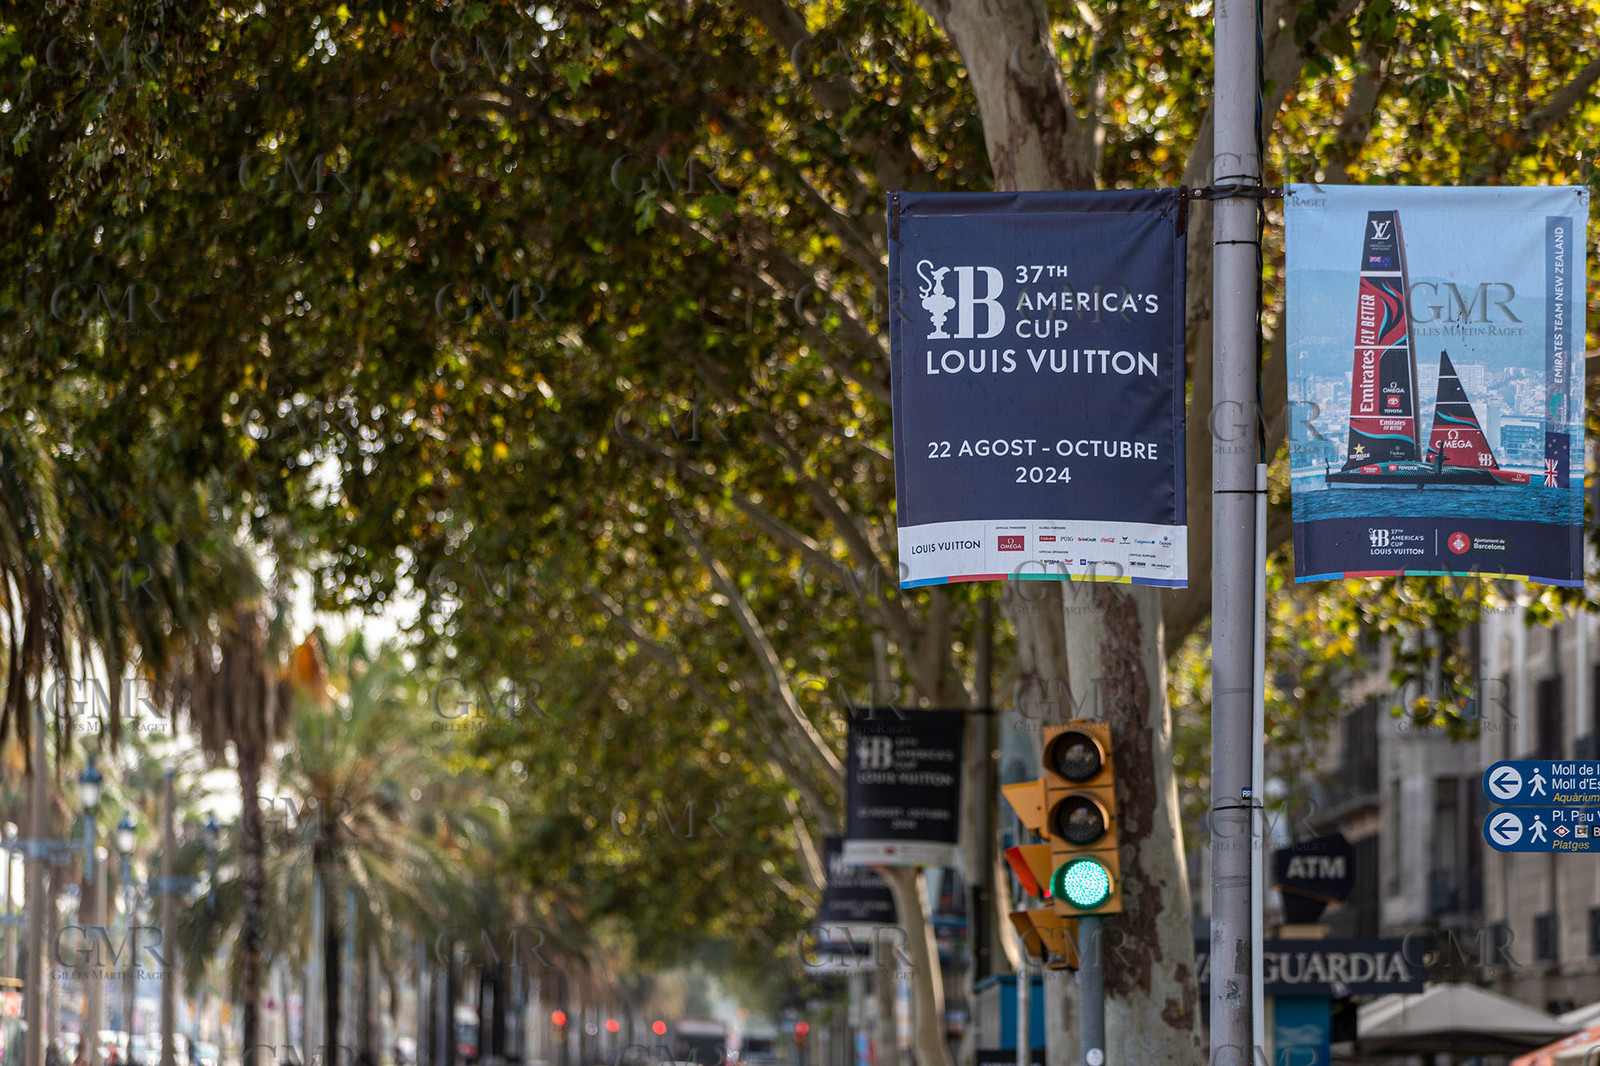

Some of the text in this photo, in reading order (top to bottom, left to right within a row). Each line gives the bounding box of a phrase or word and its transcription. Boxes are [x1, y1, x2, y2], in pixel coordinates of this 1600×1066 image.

[1554, 227, 1564, 275] ZEALAND
[1015, 265, 1068, 284] 37TH
[1554, 276, 1564, 301] NEW
[1015, 292, 1159, 314] AMERICA'S
[1554, 303, 1564, 332] TEAM
[1015, 319, 1068, 339] CUP
[926, 348, 1158, 377] LOUIS VUITTON
[1360, 294, 1375, 413] Emirates FLY BETTER
[1554, 334, 1564, 385] EMIRATES
[928, 441, 951, 459] 22
[958, 439, 1037, 458] AGOST
[1056, 439, 1158, 460] OCTUBRE
[1435, 439, 1473, 449] OMEGA
[1015, 466, 1072, 484] 2024
[911, 539, 981, 555] LOUIS VUITTON
[1473, 537, 1499, 545] Ajuntament
[1473, 542, 1506, 551] Barcelona
[1552, 764, 1576, 775] Moll
[1579, 764, 1594, 775] de
[1552, 778, 1576, 790] Moll
[1552, 792, 1600, 804] Aquàrium
[1552, 811, 1567, 822] Pl.
[1571, 811, 1594, 822] Pau
[1552, 840, 1590, 852] Platges
[1286, 856, 1347, 879] ATM
